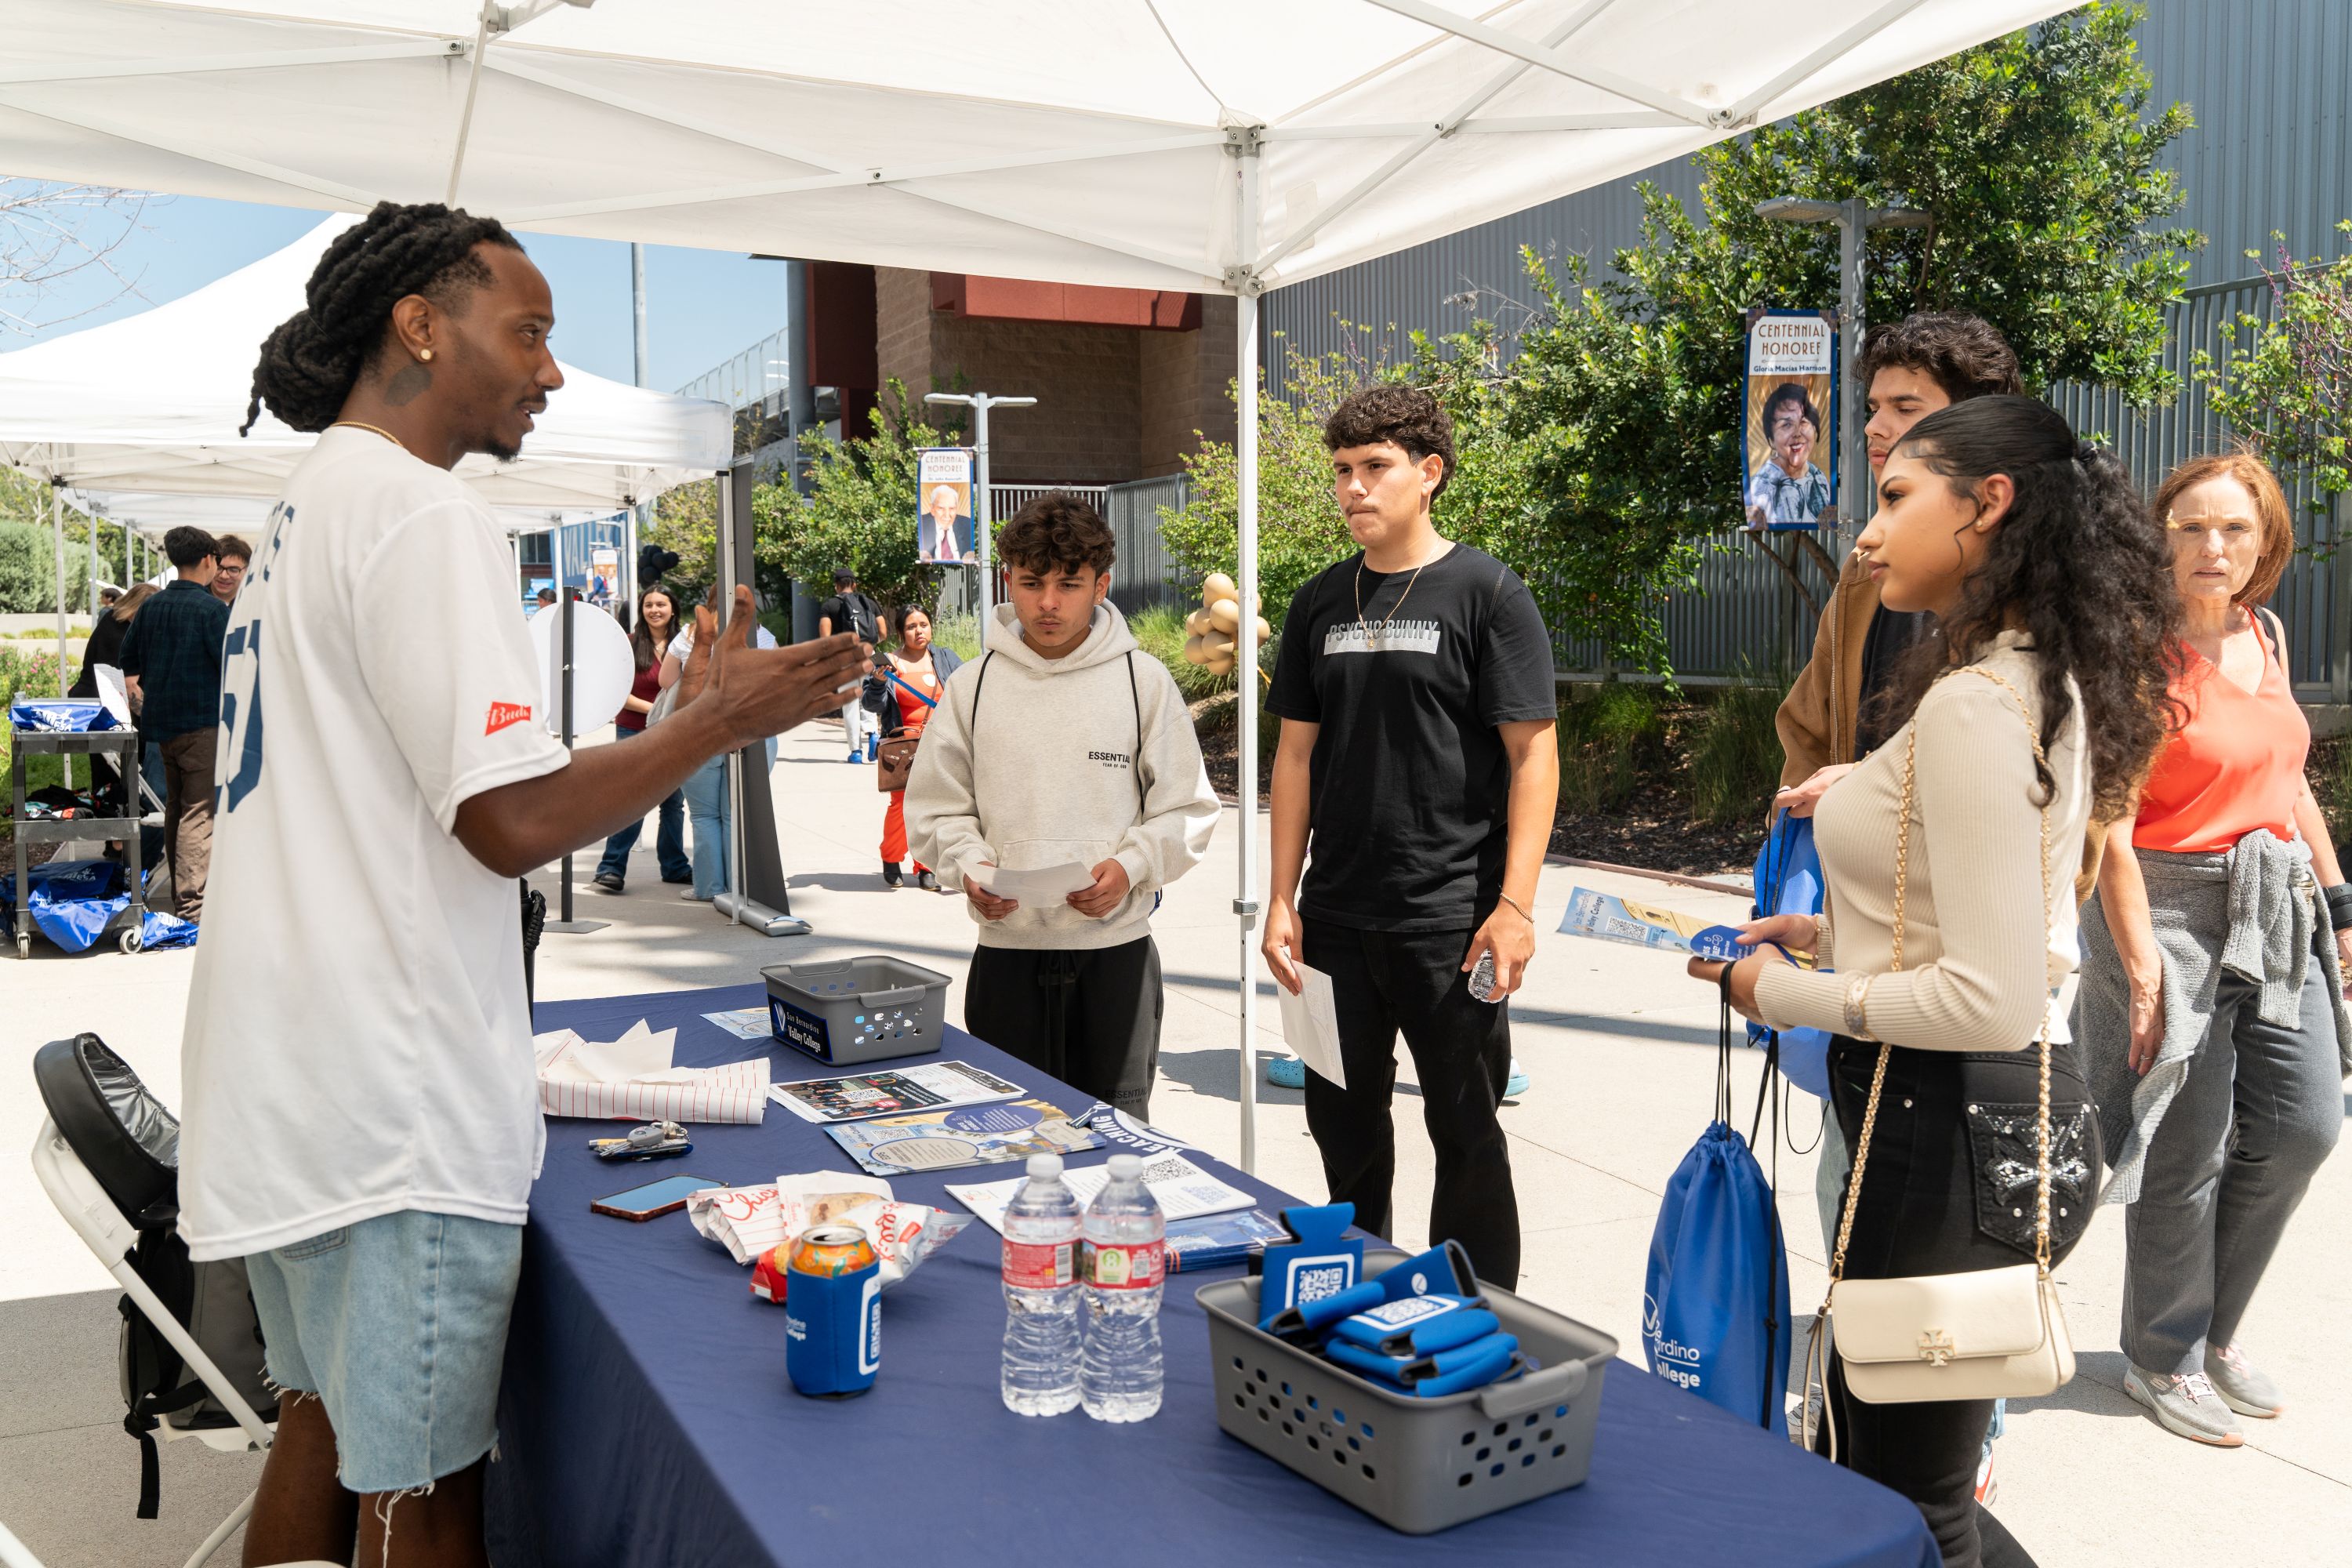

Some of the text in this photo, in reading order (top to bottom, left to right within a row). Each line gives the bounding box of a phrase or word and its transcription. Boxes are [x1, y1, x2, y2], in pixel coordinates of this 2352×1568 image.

[1759, 324, 1824, 337] CENTENNIAL
[1762, 342, 1820, 355] HONOREE
[925, 455, 965, 463] CENTENNIAL
[1328, 619, 1438, 642] PSYCHO BUNNY
[1088, 751, 1131, 763] ESSENTIA
[1591, 896, 1604, 915] College
[786, 1011, 820, 1035] San Bernardino
[788, 1025, 821, 1053] Valley College
[1105, 1087, 1148, 1098] ESSENTIAL
[1656, 1361, 1700, 1389] ollege
